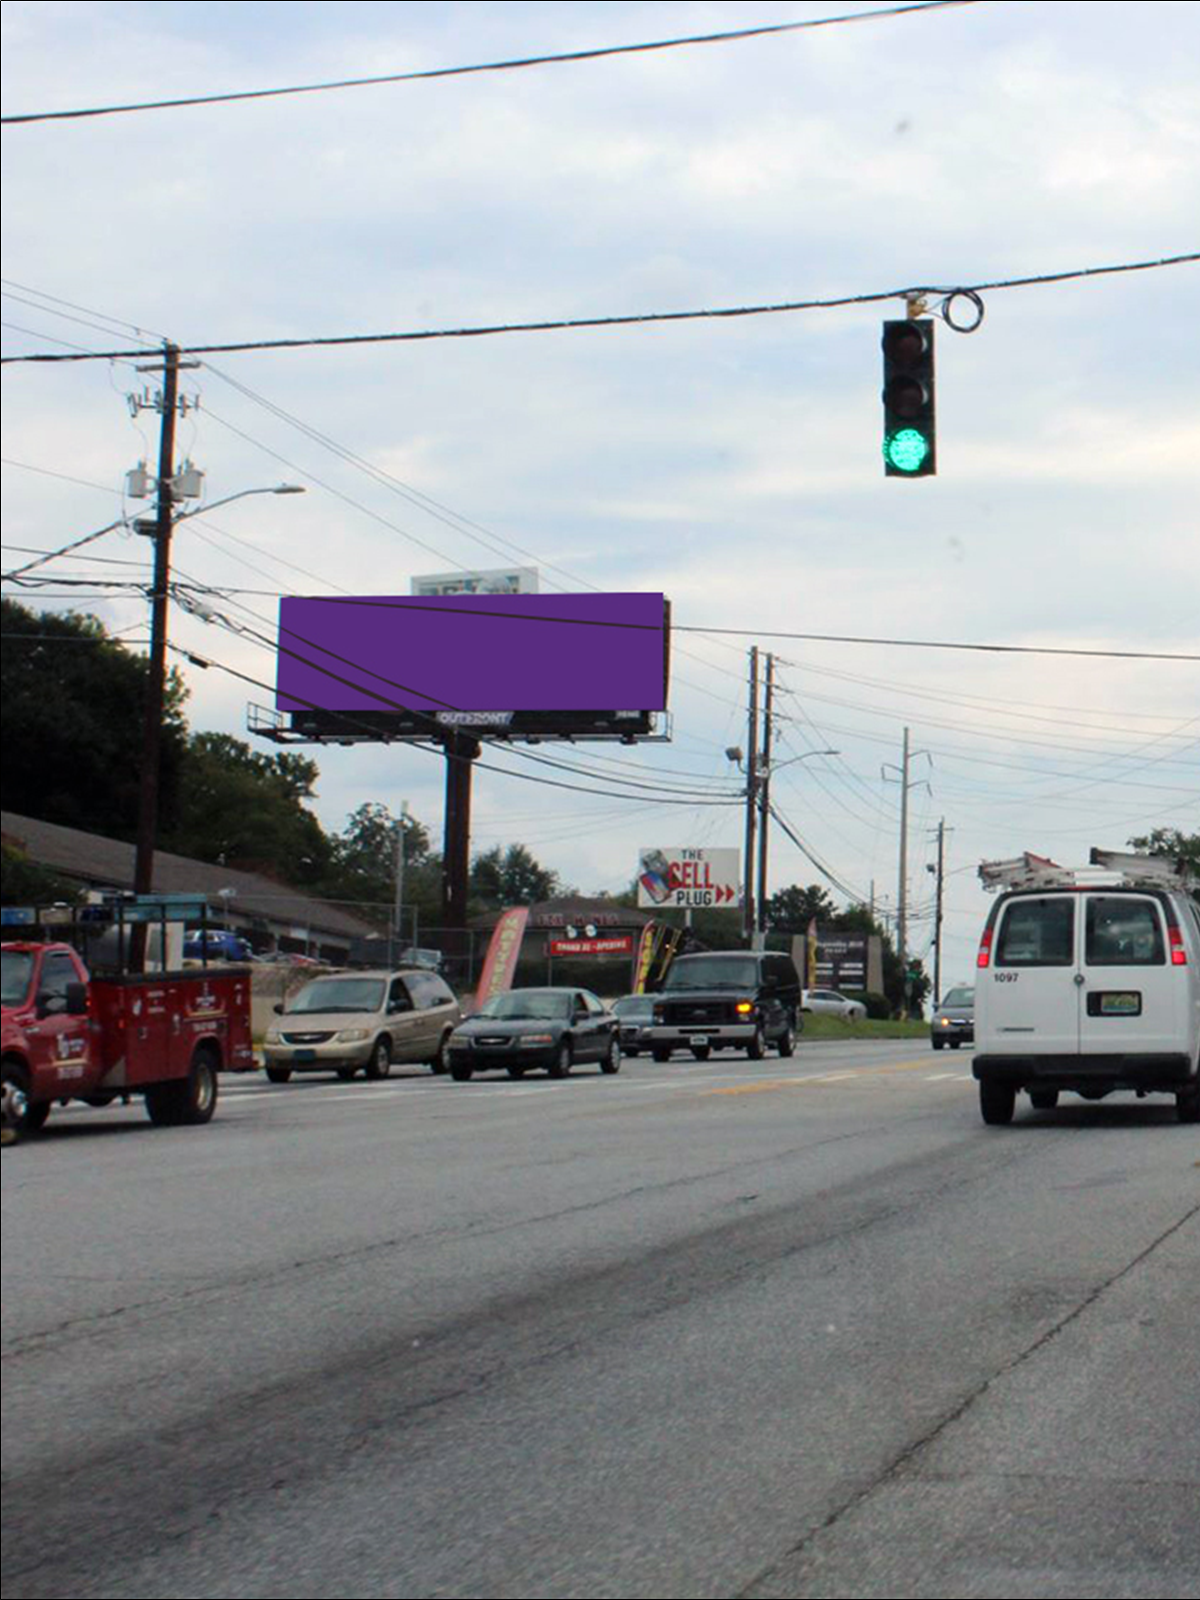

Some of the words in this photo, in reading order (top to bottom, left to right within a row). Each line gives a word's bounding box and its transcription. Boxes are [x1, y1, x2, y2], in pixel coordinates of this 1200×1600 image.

[681, 849, 704, 860] THE
[676, 891, 712, 906] PLUG
[994, 973, 1018, 983] 1097
